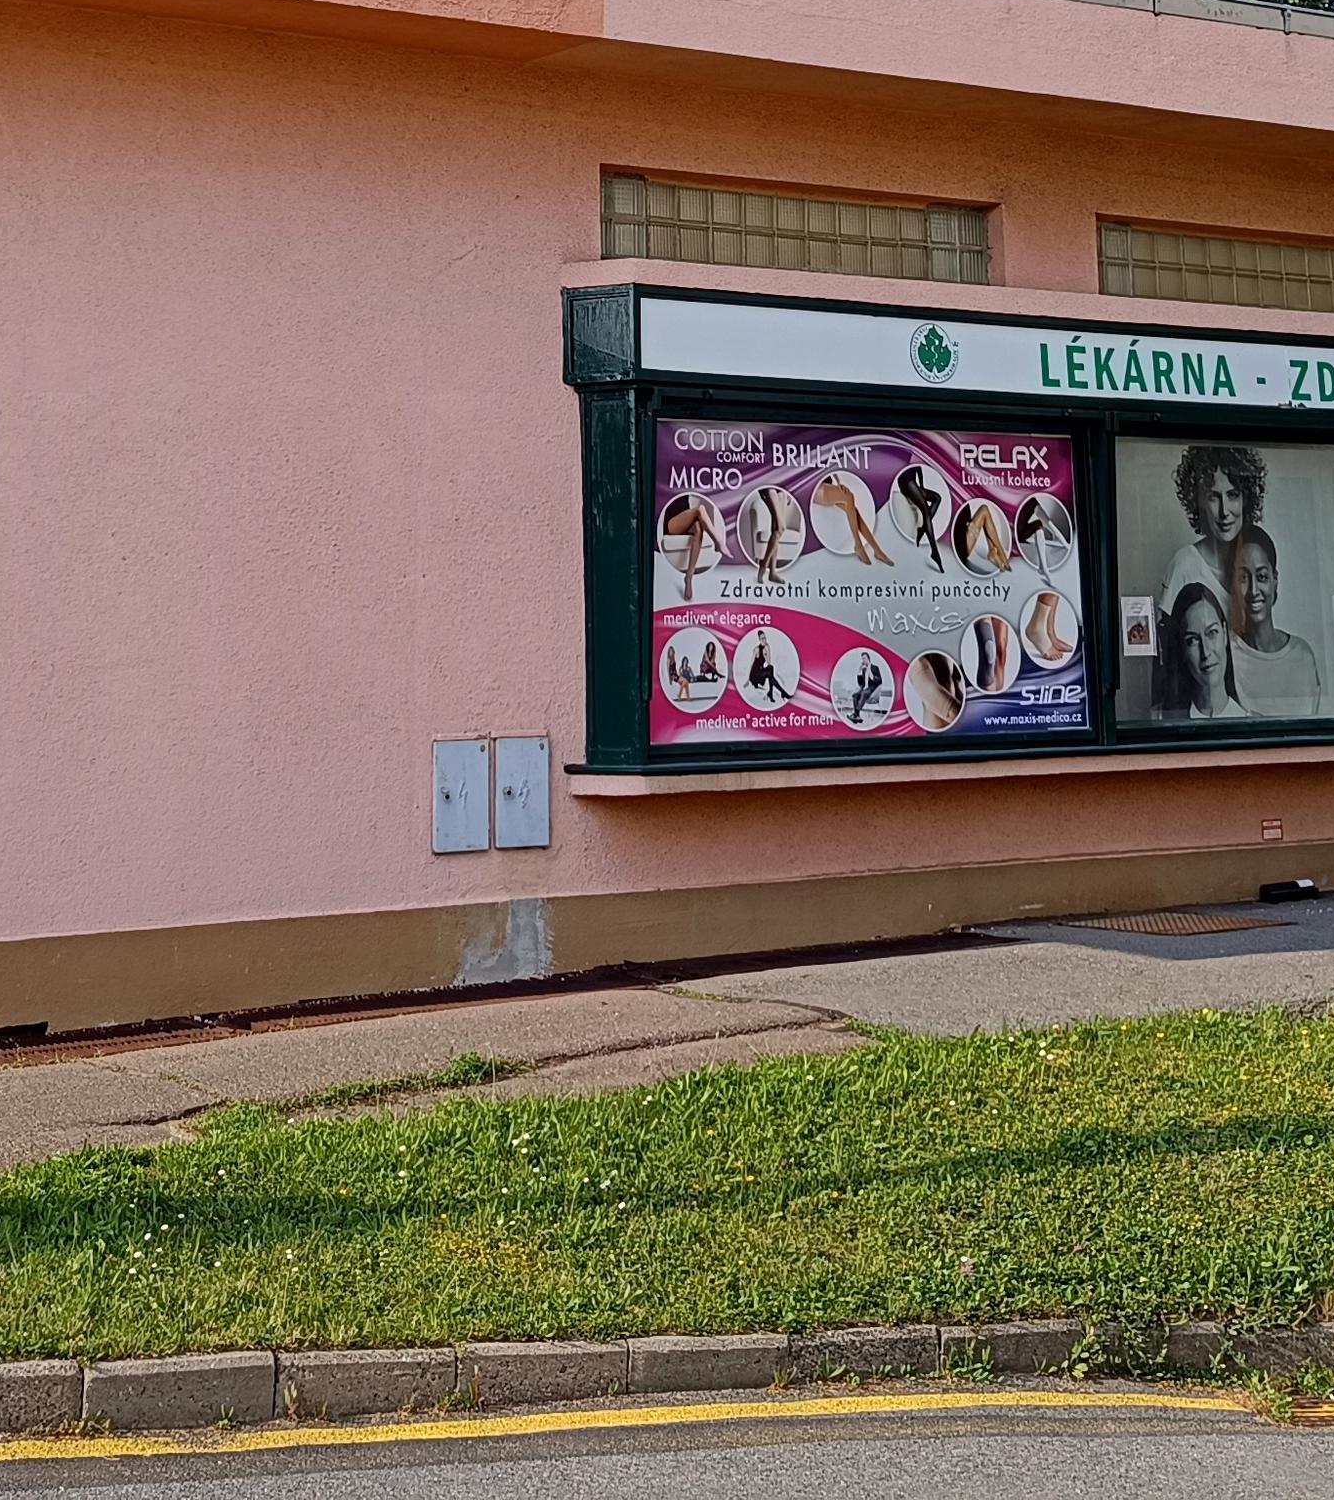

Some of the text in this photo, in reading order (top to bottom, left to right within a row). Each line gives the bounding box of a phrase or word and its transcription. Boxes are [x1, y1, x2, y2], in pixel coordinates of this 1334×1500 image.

[1039, 335, 1237, 397] LÉKÁRNA
[674, 428, 764, 452] COTTON
[717, 452, 765, 464] COMFORT
[772, 443, 872, 469] BRILLANT
[959, 443, 1049, 470] RELAX
[669, 466, 742, 490] MICRO
[961, 471, 1051, 487] Luxusní kolekce
[720, 579, 1011, 602] Zdravotní kompresivní punčochy
[719, 611, 771, 627] elegance
[751, 713, 787, 728] active
[789, 712, 807, 726] for
[808, 714, 834, 726] men
